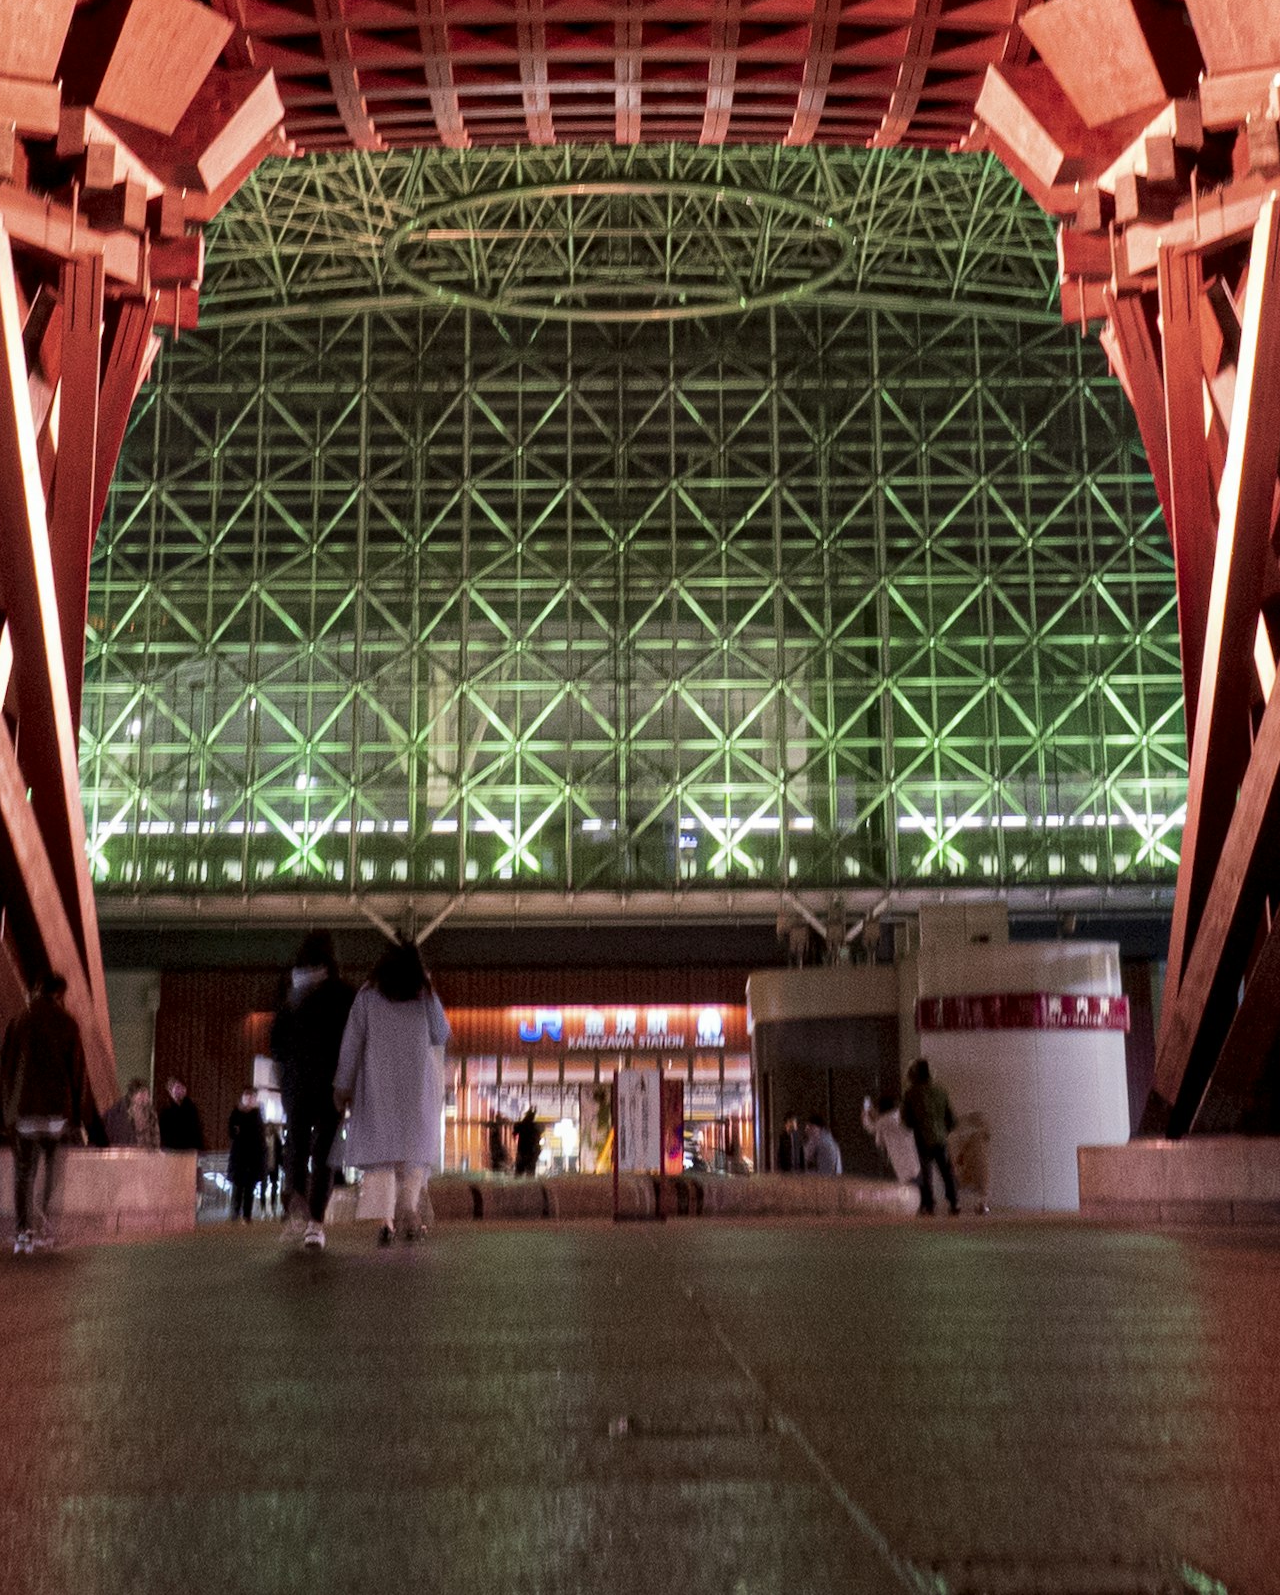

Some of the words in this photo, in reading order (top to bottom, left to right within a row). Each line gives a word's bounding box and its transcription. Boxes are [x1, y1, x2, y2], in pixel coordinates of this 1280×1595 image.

[520, 1009, 562, 1042] JR
[568, 1034, 635, 1050] KANAZAWA
[639, 1033, 685, 1049] STATION
